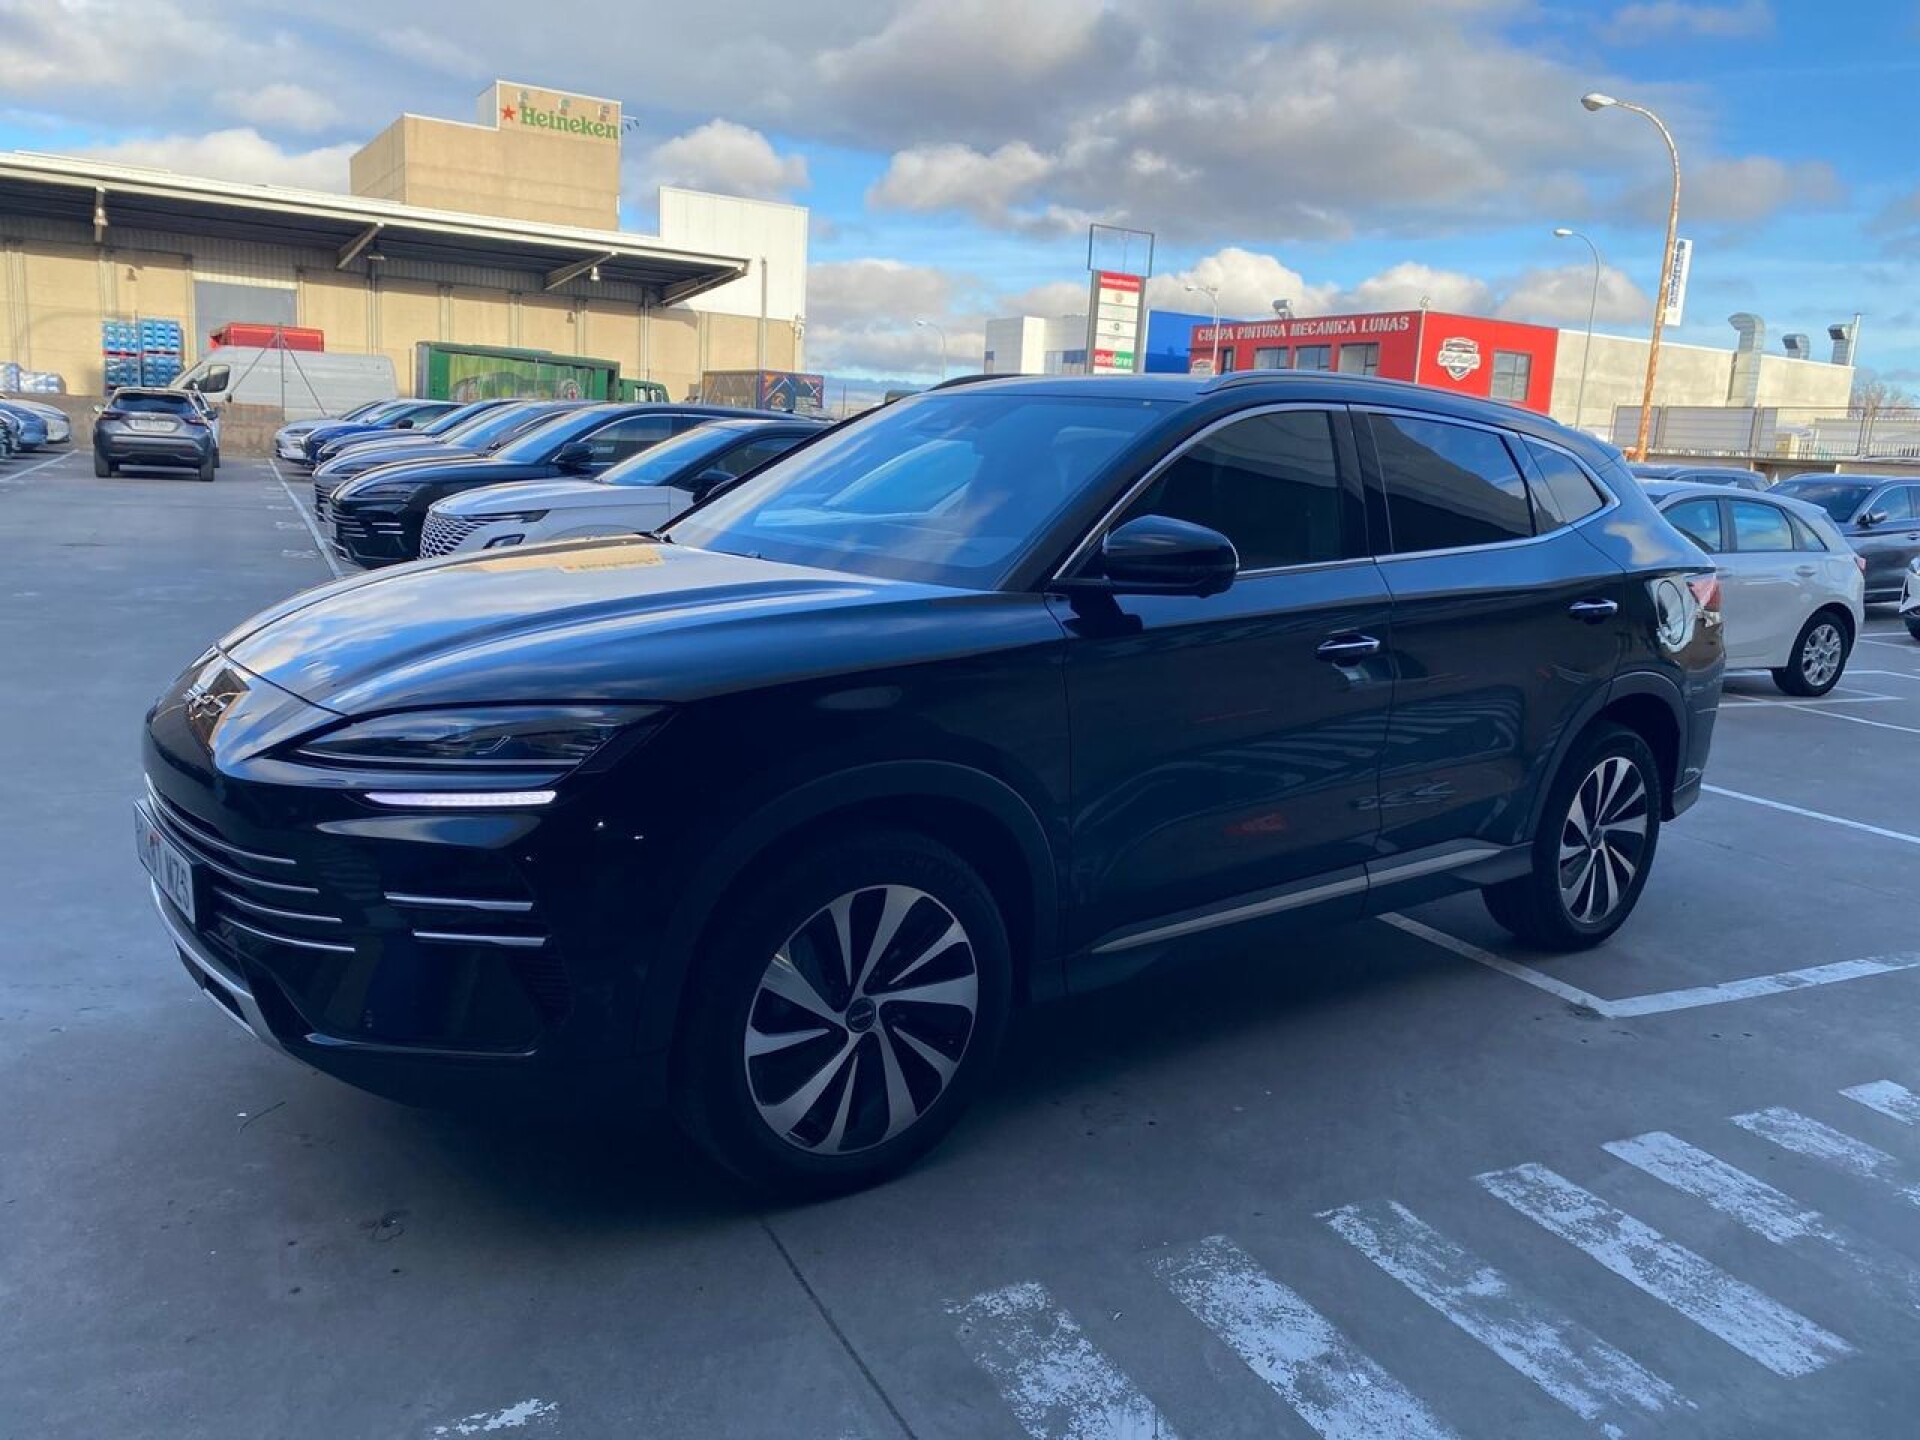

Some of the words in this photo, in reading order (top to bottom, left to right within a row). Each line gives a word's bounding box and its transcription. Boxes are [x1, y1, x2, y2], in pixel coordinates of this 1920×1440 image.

[520, 106, 619, 139] Heineken
[1237, 323, 1287, 340] PINTURA
[1290, 319, 1357, 337] MECANICA
[1361, 315, 1410, 334] LUNAS
